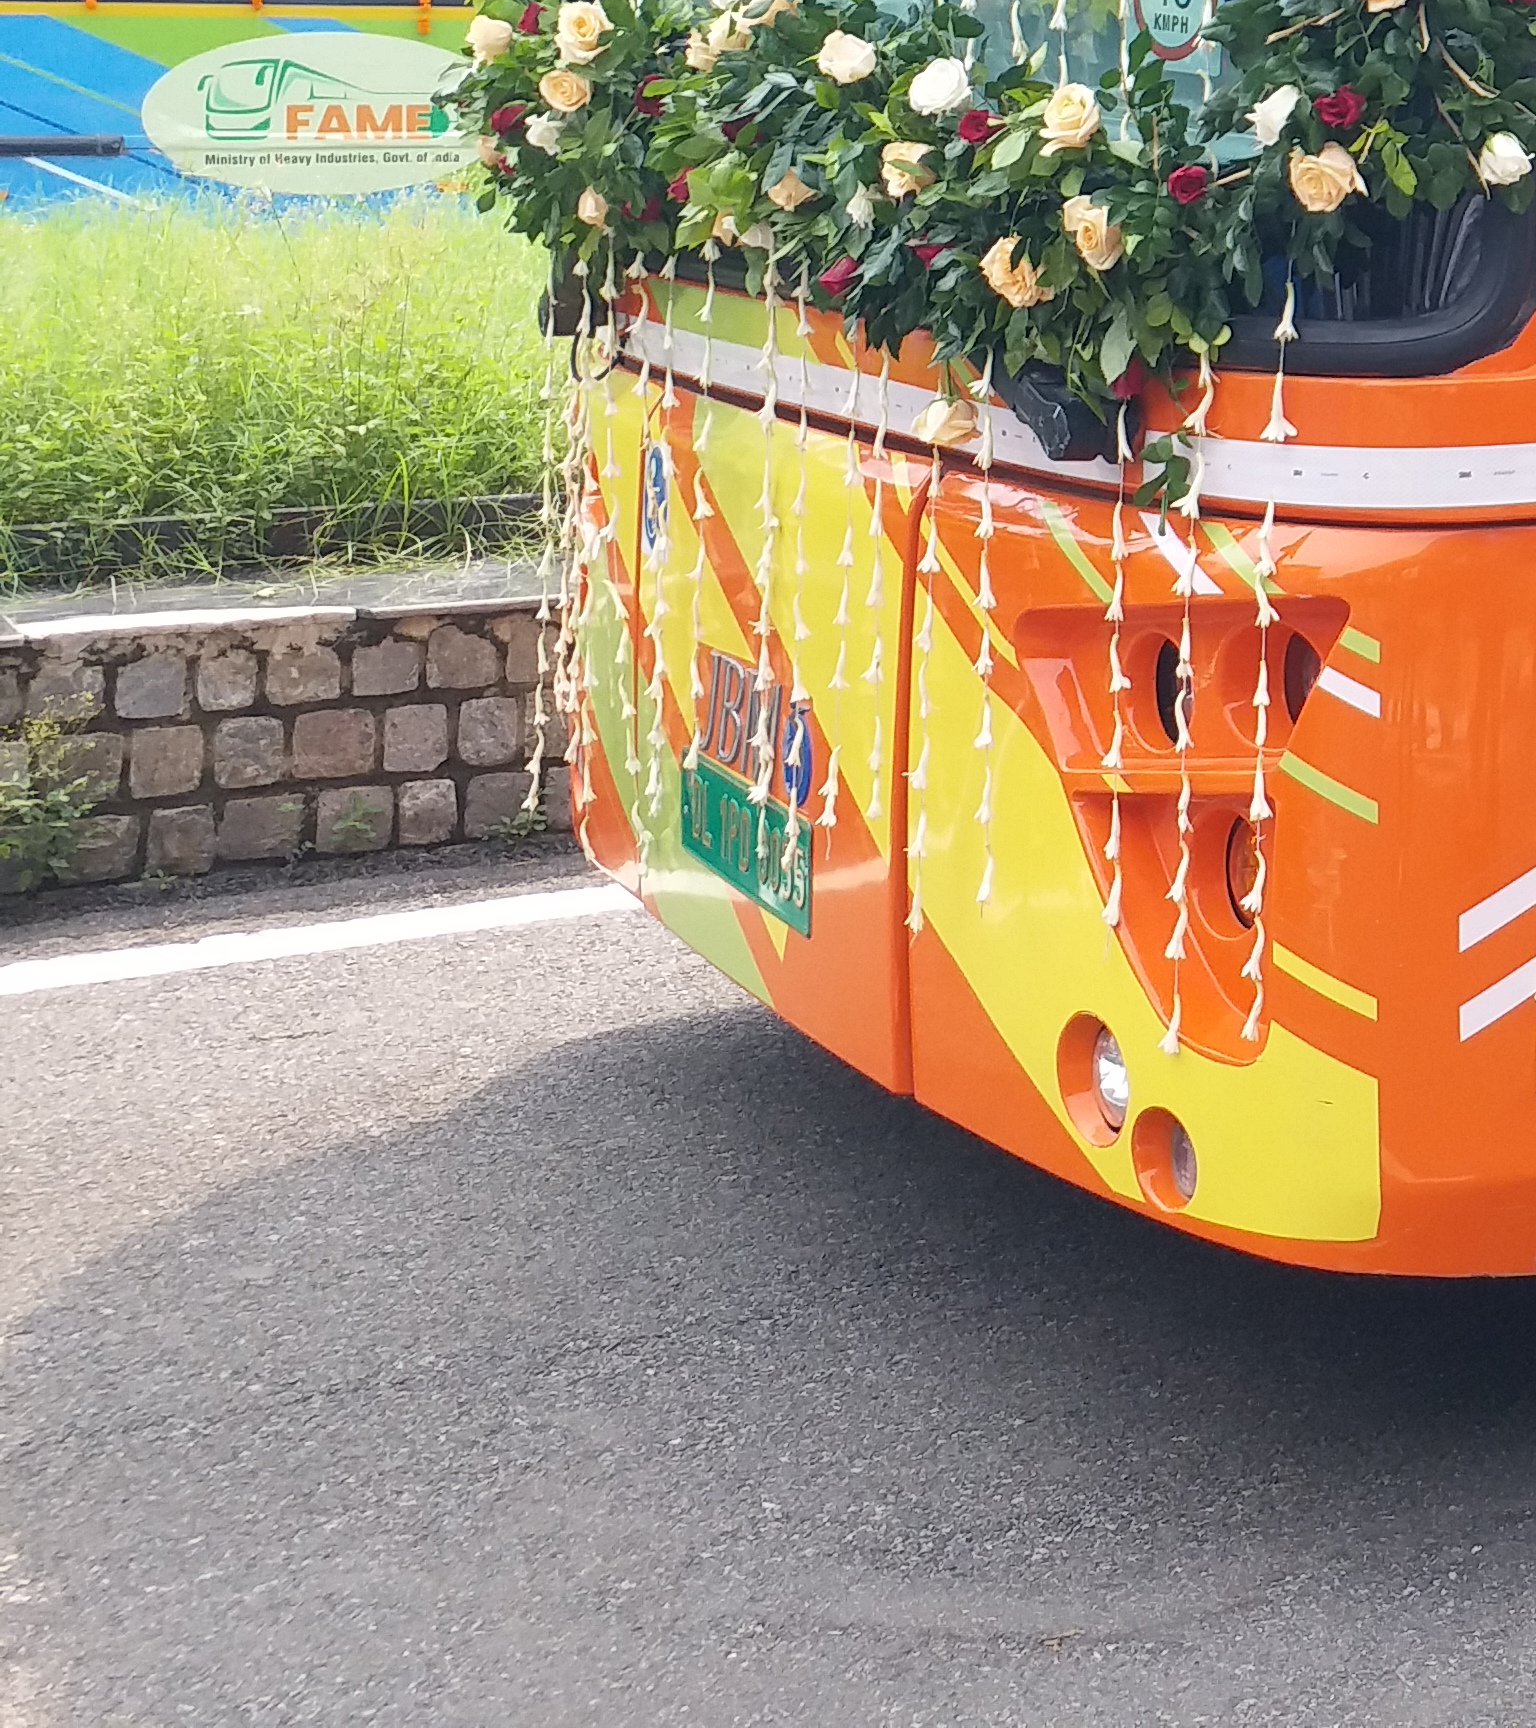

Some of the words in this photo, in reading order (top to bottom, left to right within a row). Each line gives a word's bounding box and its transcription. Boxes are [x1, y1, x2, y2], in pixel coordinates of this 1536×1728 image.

[1153, 12, 1189, 34] KMPH
[286, 104, 432, 140] FAME
[205, 154, 255, 166] Ministry
[260, 153, 271, 164] of
[315, 152, 379, 165] Industries,
[416, 152, 428, 163] of
[432, 152, 460, 163] ndia
[698, 648, 783, 792] JBM
[690, 773, 713, 849] DL
